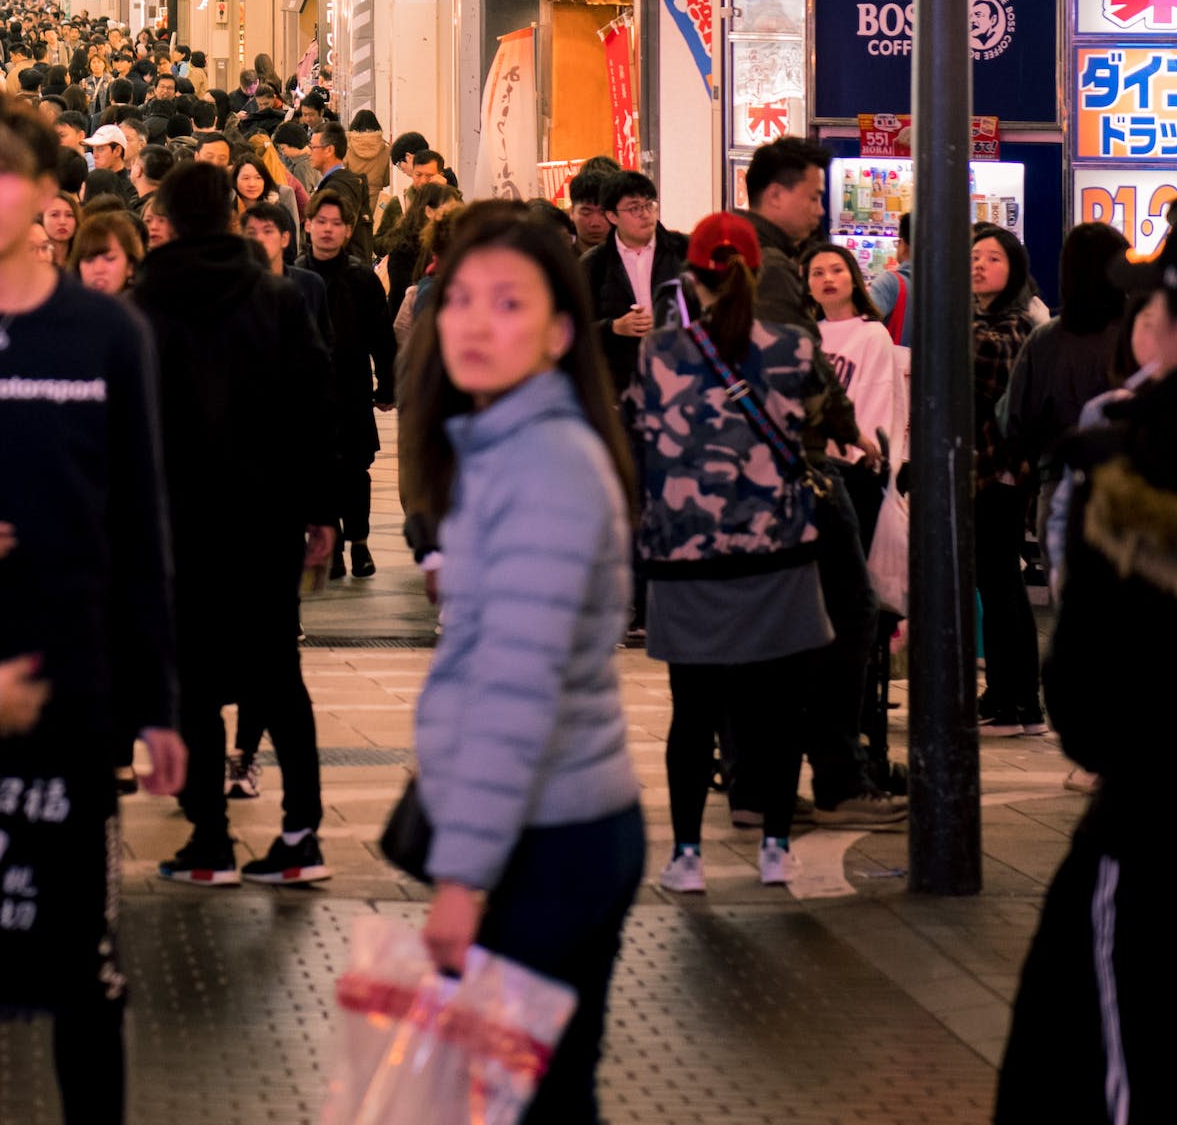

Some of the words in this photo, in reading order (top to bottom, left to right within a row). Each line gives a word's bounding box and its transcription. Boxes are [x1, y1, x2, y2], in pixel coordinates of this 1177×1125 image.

[856, 3, 914, 37] BOS
[867, 39, 912, 56] COFF
[866, 132, 890, 146] 551
[862, 145, 893, 155] HORAI
[973, 140, 998, 154] るで!
